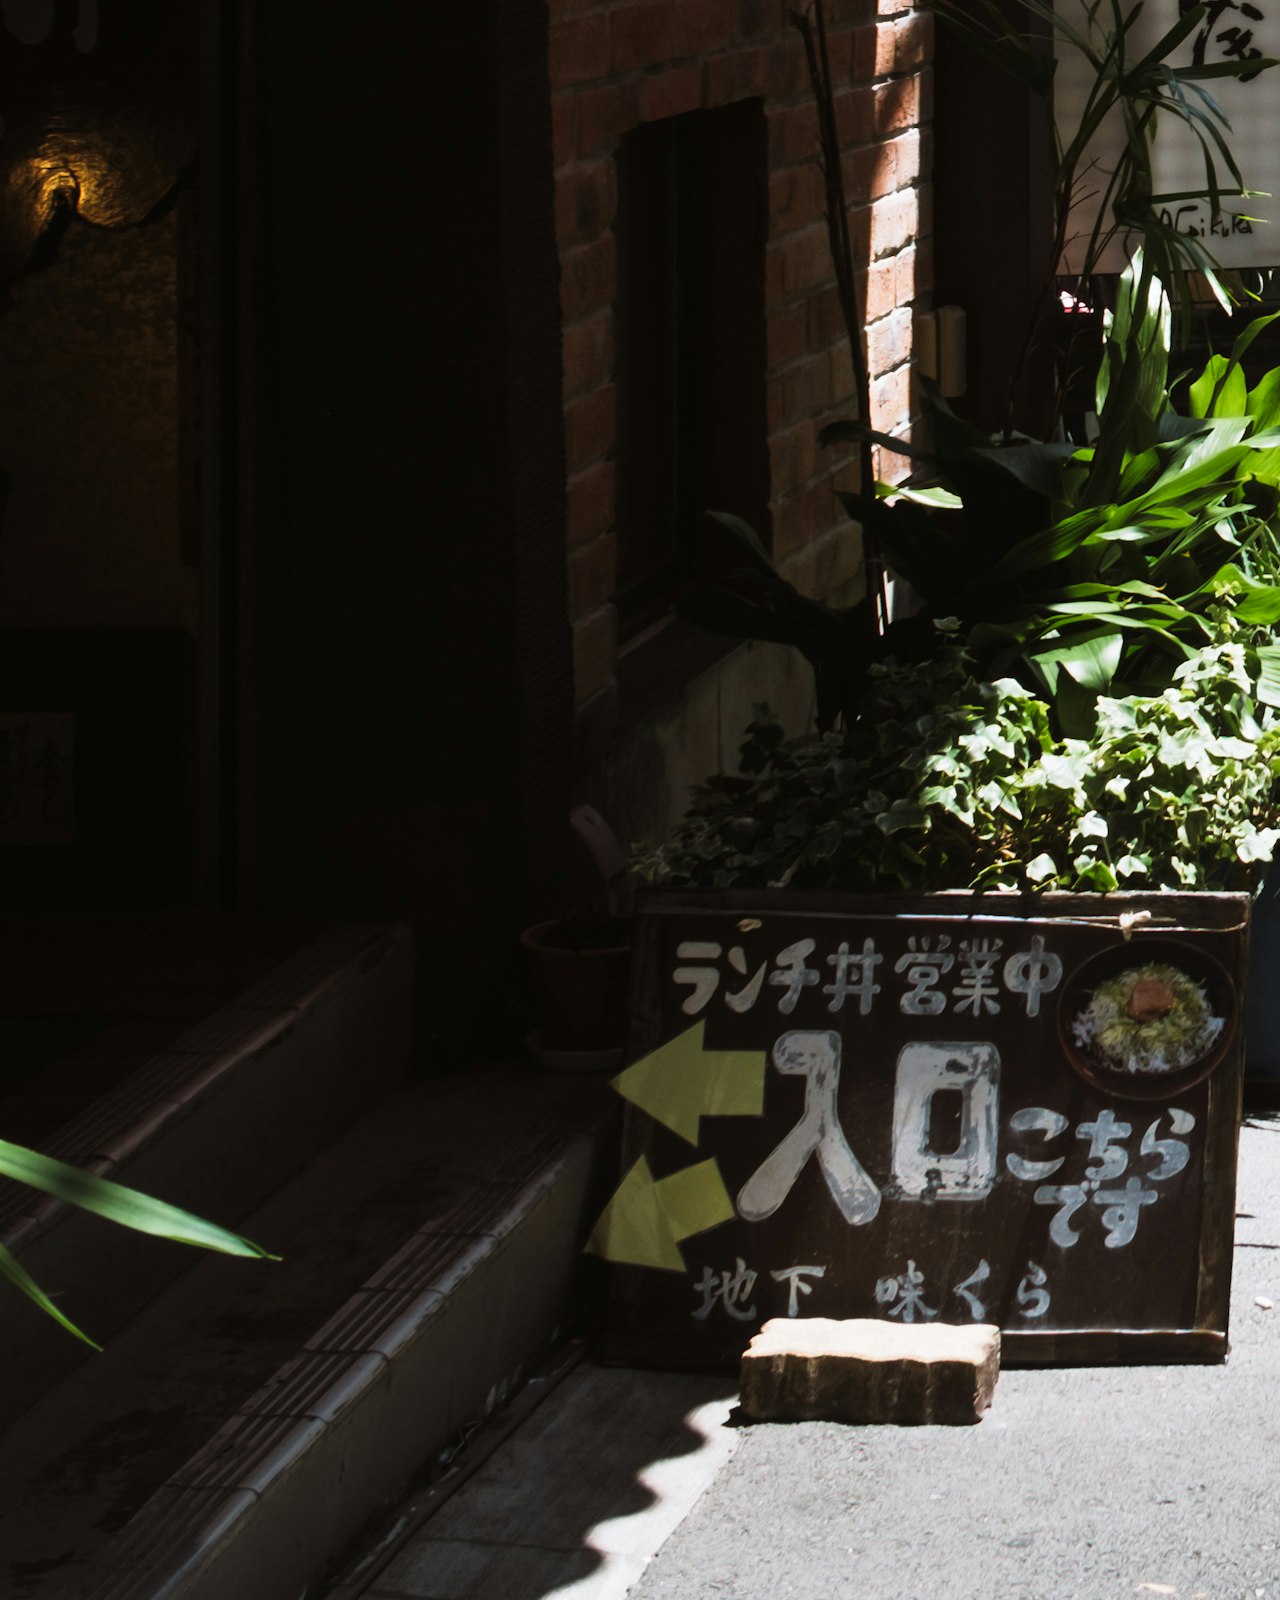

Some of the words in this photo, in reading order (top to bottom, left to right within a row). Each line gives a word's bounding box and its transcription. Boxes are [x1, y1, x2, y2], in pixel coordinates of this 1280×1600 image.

[736, 1030, 1002, 1226] 入口
[1006, 1107, 1197, 1182] こちら
[1034, 1175, 1159, 1249] です
[693, 1259, 826, 1322] 地下
[875, 1257, 1053, 1323] 味くら
